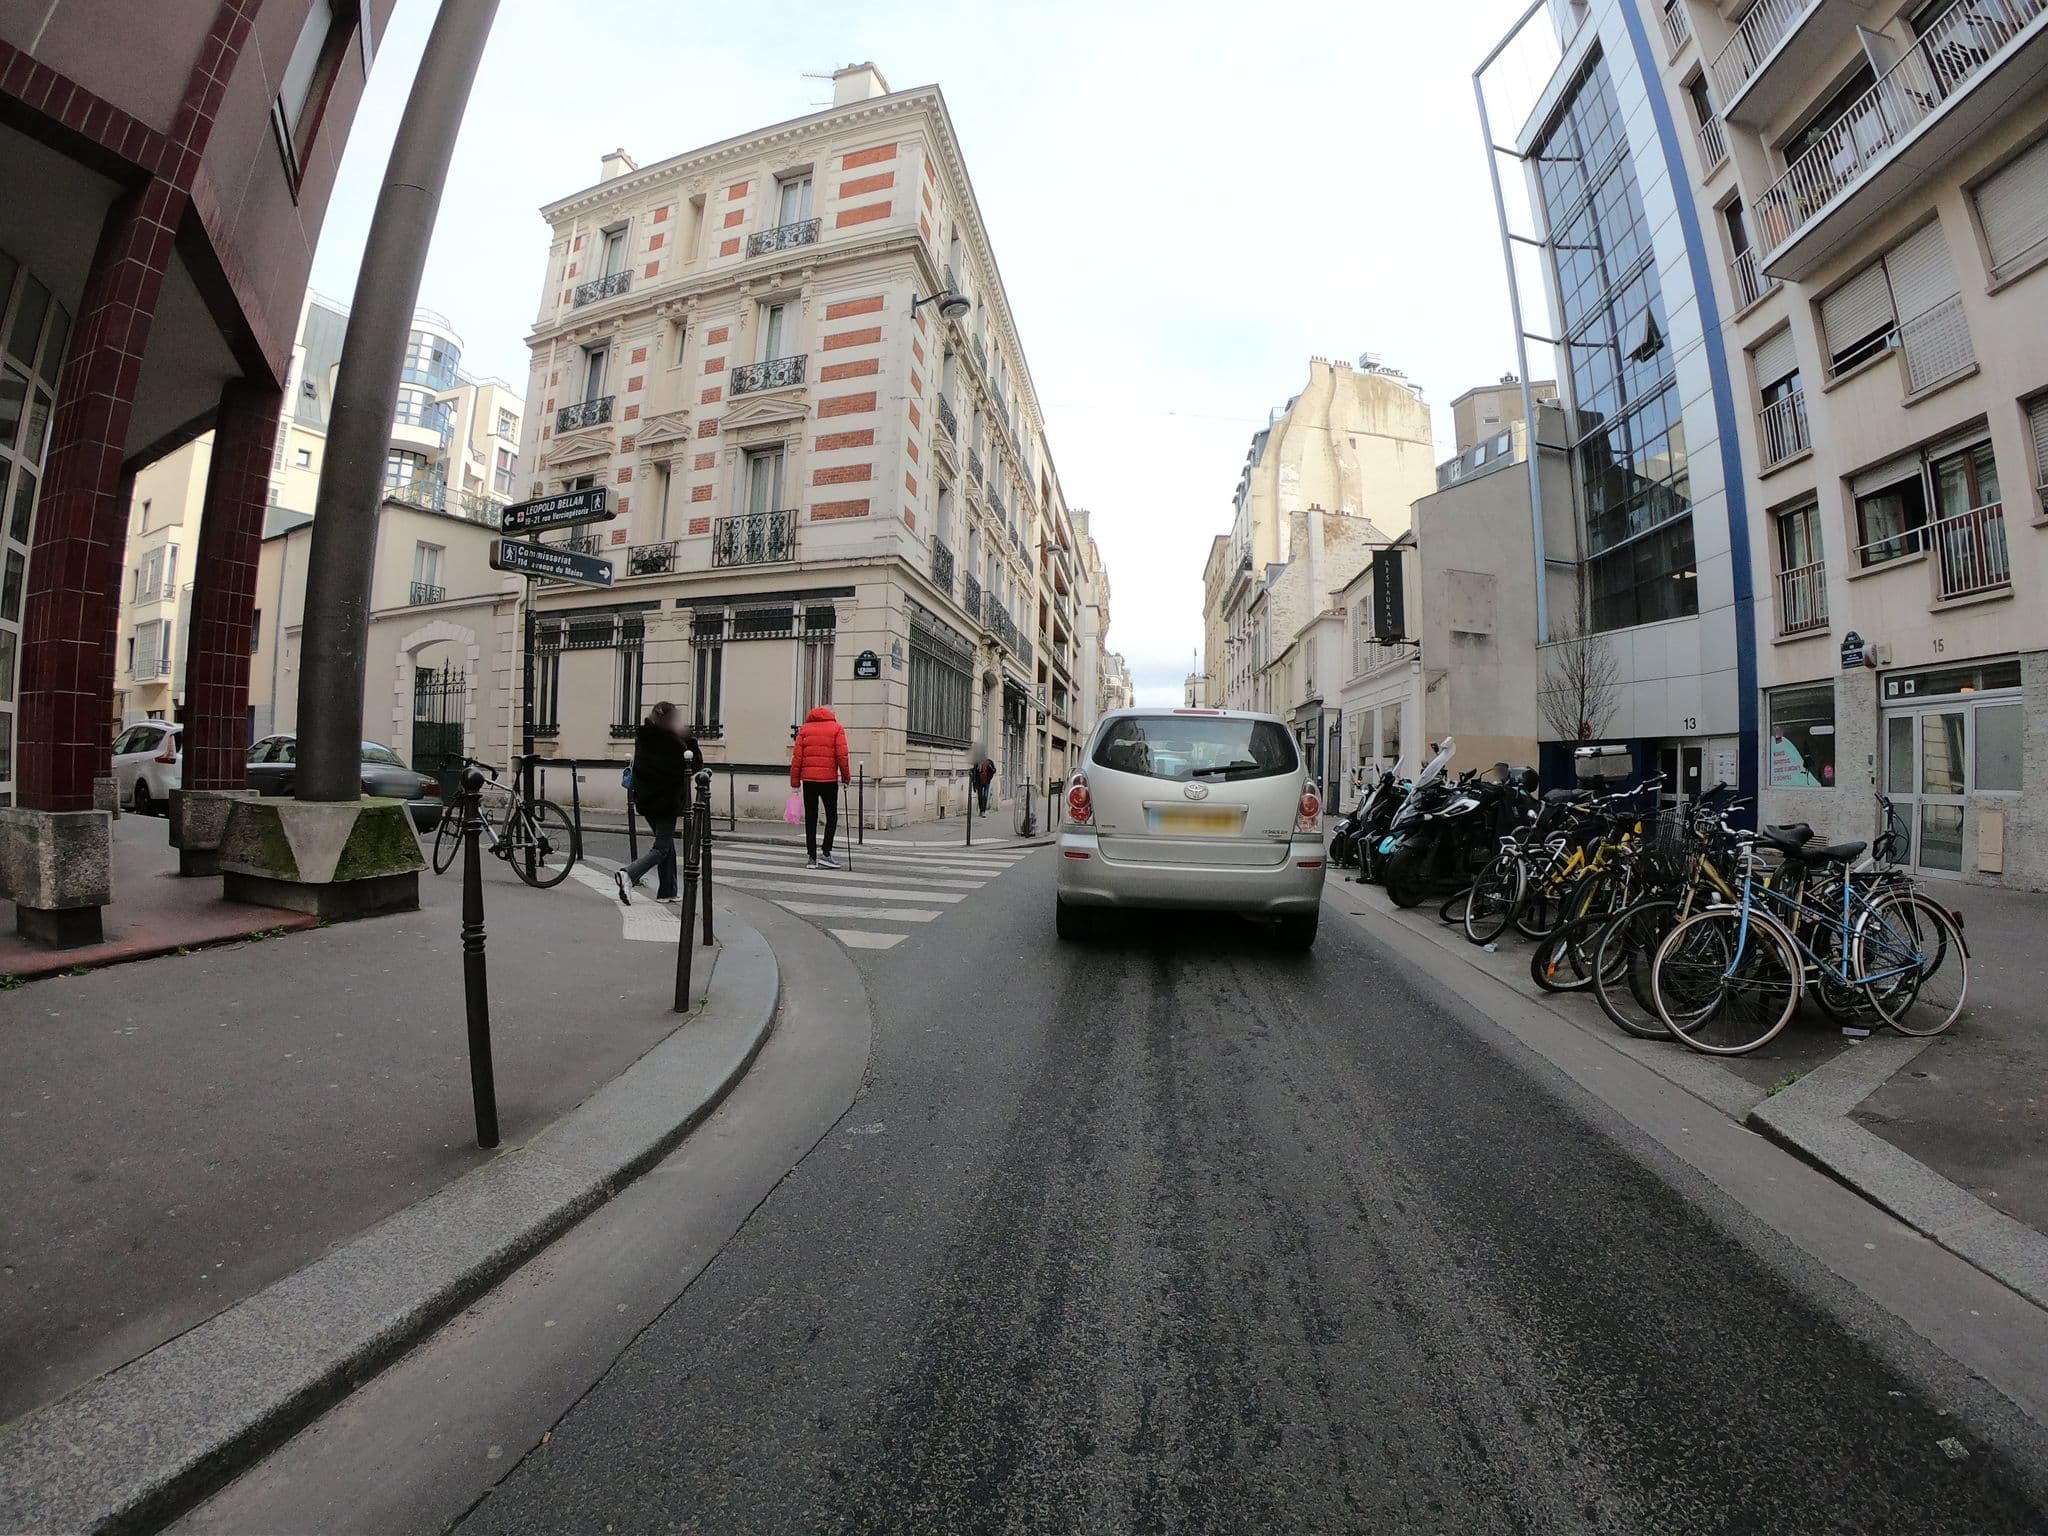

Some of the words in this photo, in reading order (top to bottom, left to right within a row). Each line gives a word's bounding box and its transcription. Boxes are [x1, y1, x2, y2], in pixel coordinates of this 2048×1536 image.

[526, 501, 556, 516] LEOPOLD
[557, 495, 584, 510] BELLAN
[518, 546, 572, 566] Commissariat
[518, 558, 528, 566] 114
[556, 566, 564, 574] du
[564, 567, 584, 578] Maine
[1932, 638, 1945, 654] 15
[1684, 717, 1697, 730] 13
